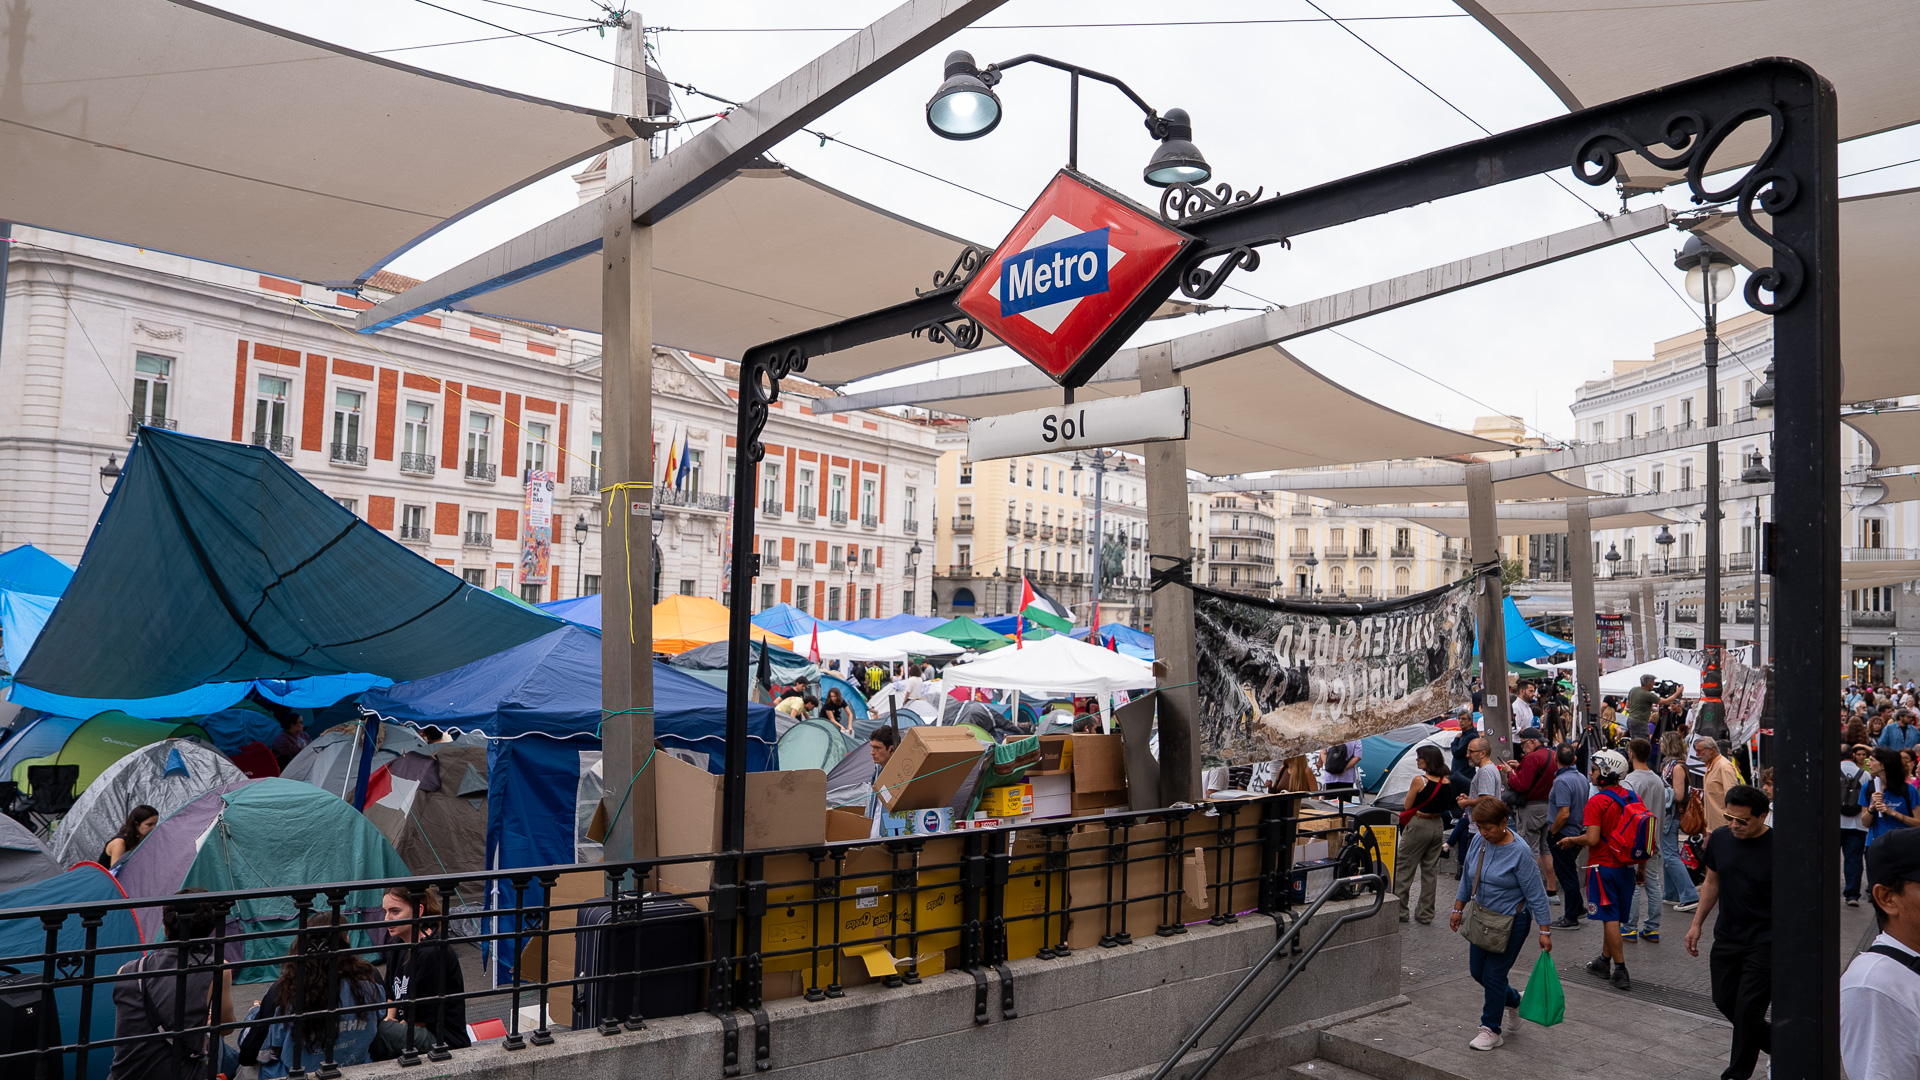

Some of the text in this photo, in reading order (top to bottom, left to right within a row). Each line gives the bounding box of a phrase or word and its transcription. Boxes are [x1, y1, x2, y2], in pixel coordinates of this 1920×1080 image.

[1008, 250, 1099, 302] Metro
[1042, 409, 1086, 443] Sol
[102, 736, 138, 748] Quechua
[925, 892, 945, 911] Cheetos
[845, 912, 871, 930] Cheetos
